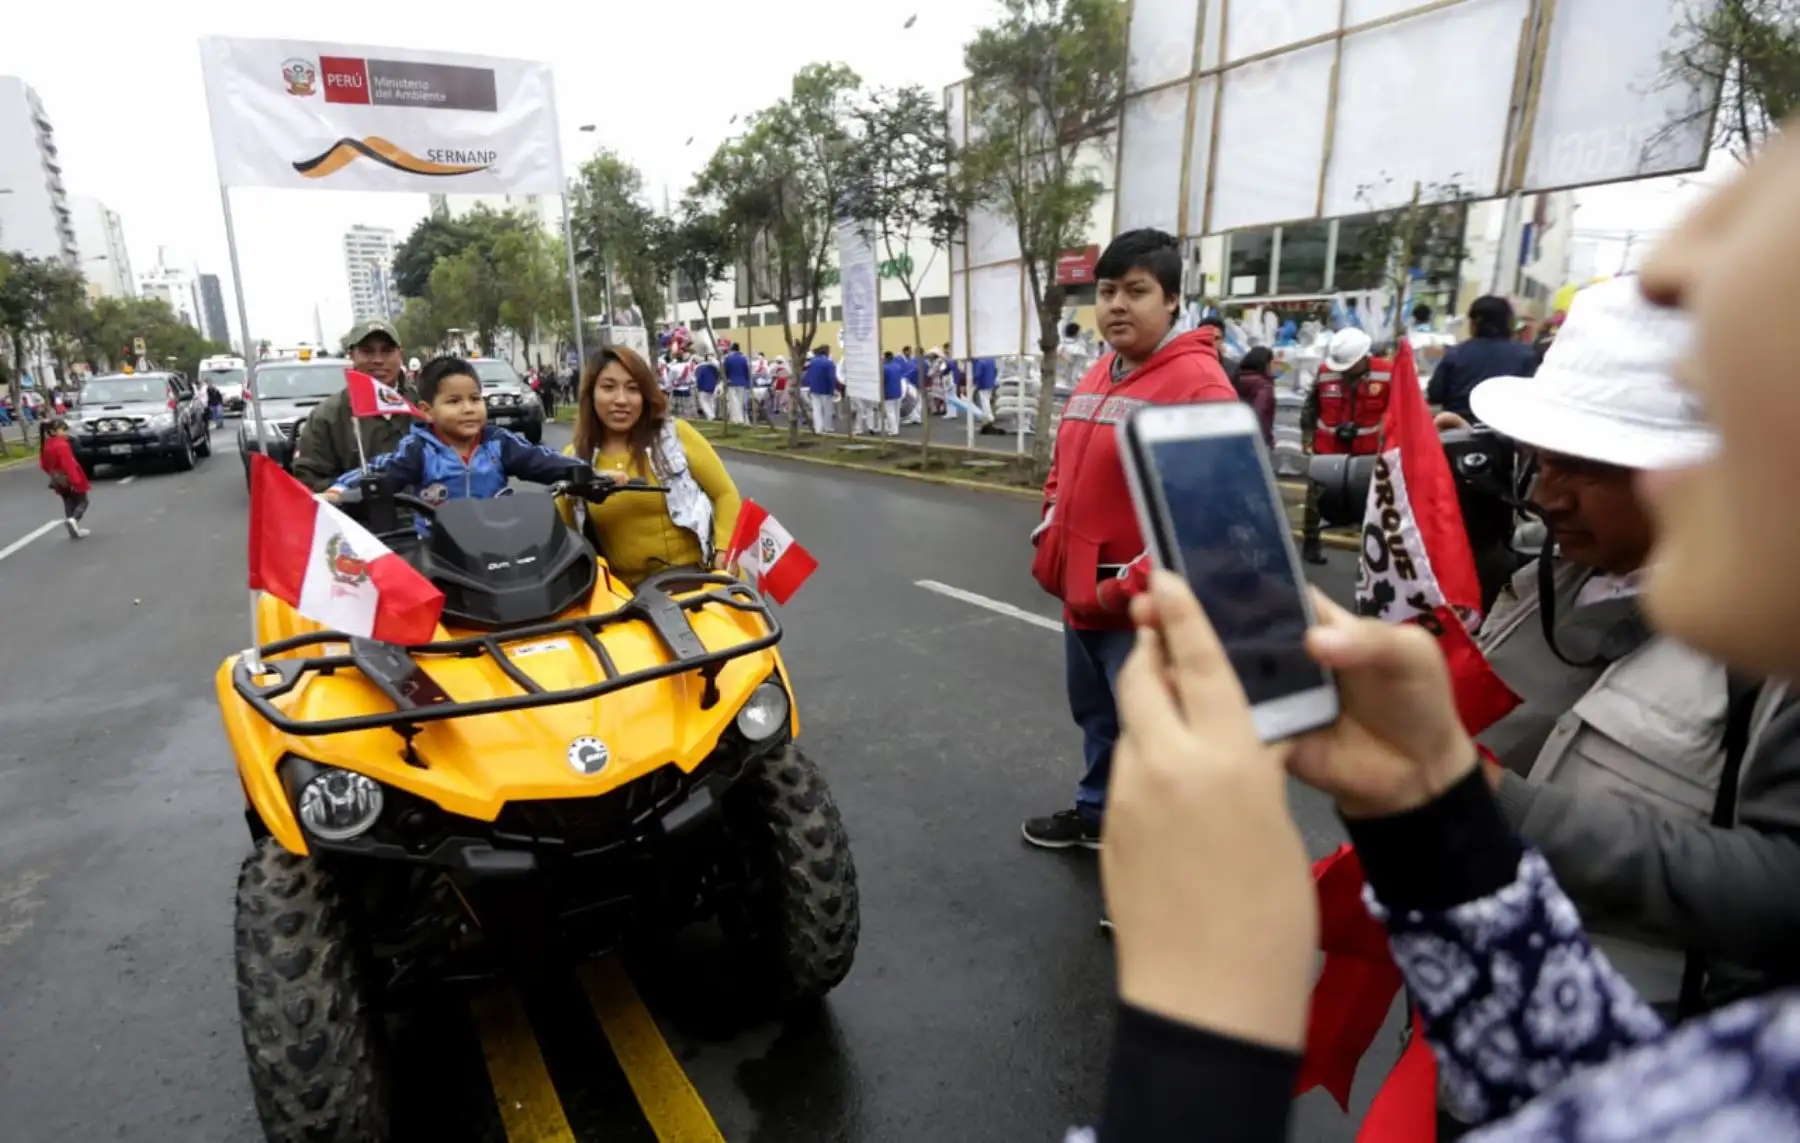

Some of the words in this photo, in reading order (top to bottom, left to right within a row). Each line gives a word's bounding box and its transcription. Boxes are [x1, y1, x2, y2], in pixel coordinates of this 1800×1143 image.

[327, 72, 362, 88] PERÚ
[374, 76, 430, 90] Ministerio
[375, 89, 393, 99] del
[394, 90, 448, 102] Ambiente
[427, 148, 498, 164] SERNANP
